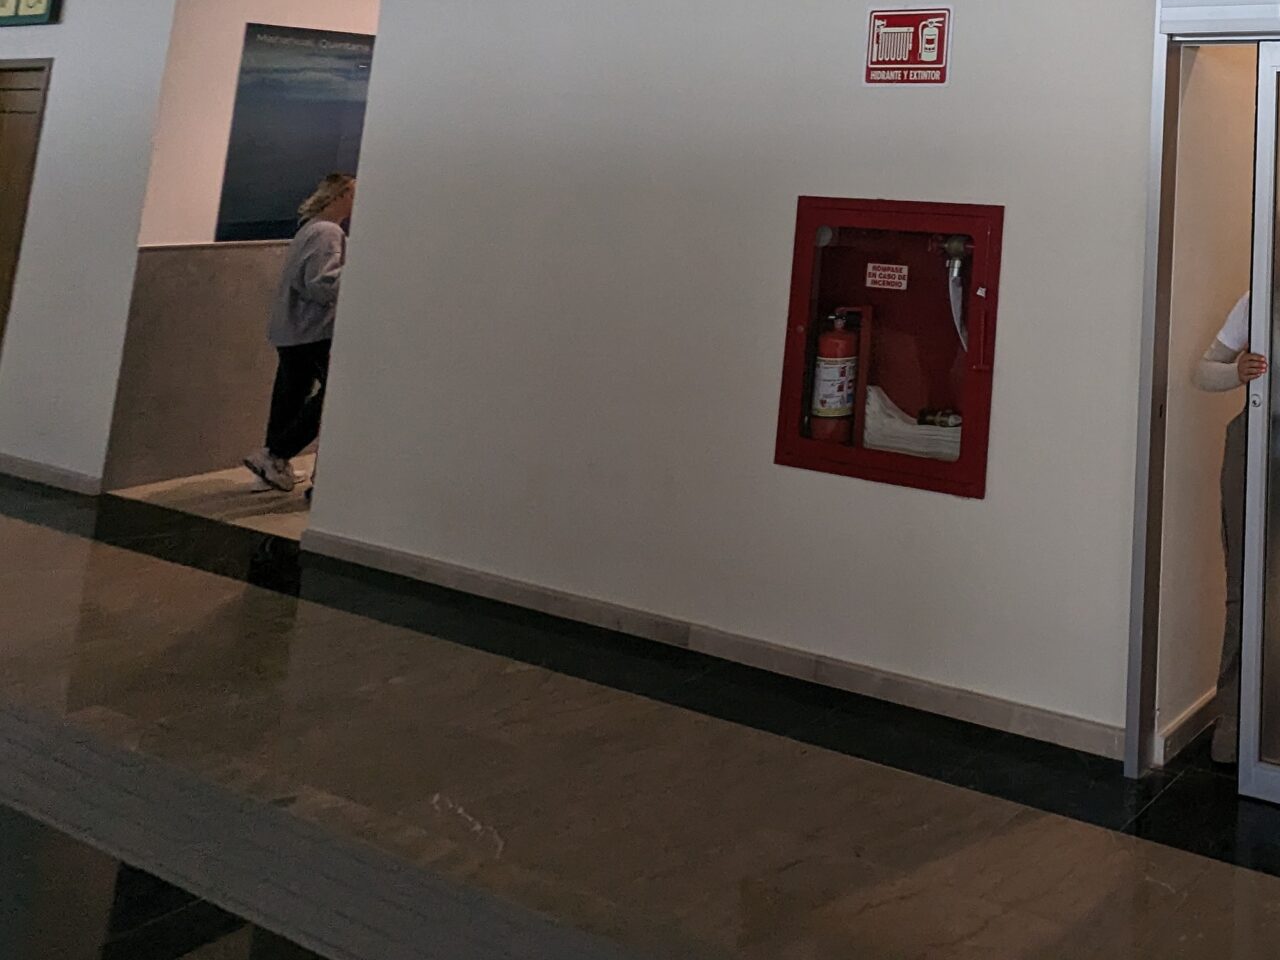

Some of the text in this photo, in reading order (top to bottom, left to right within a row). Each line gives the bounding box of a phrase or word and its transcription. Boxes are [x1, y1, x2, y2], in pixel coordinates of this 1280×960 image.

[870, 70, 941, 80] HIDRANTE Y EXTINTOR
[868, 271, 877, 280] EN
[878, 272, 896, 281] CASO
[870, 279, 903, 288] INCENDIO
